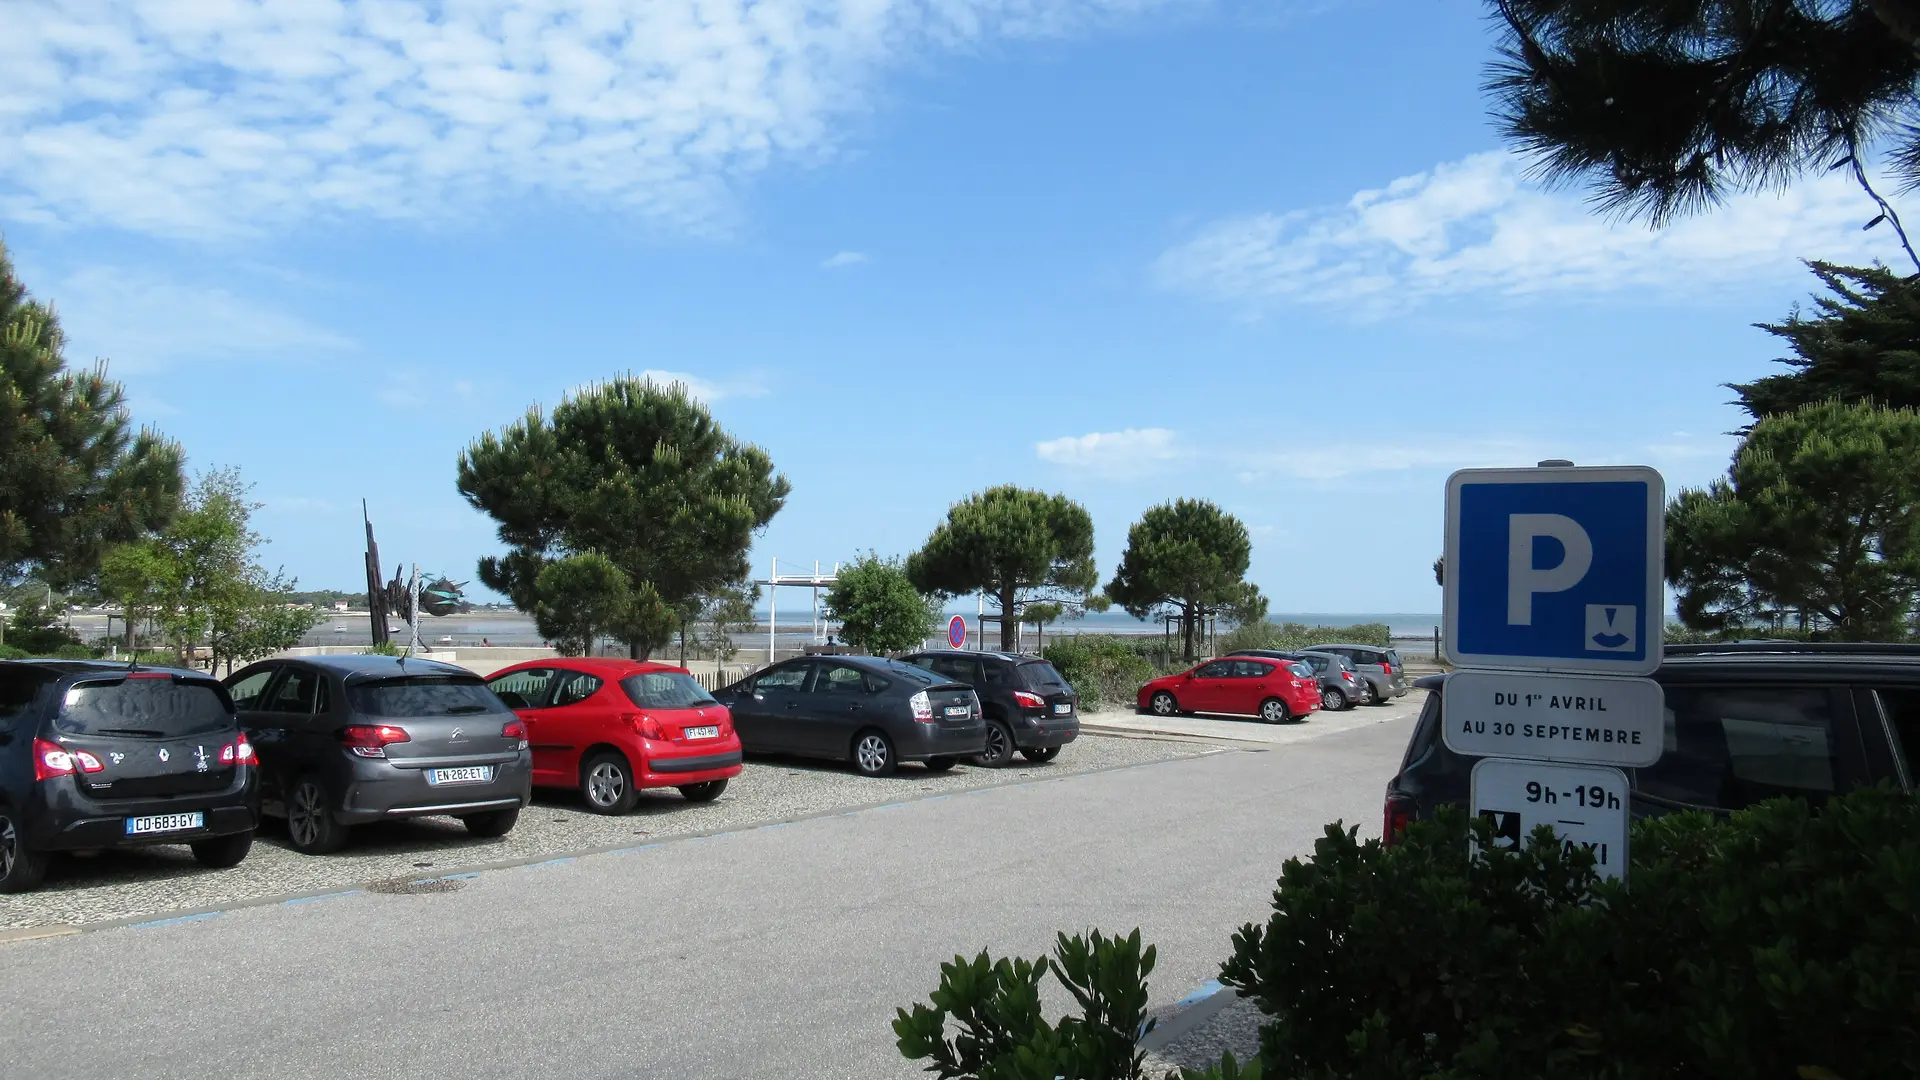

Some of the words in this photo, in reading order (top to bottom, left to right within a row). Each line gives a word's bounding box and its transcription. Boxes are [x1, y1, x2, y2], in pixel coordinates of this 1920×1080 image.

[1507, 513, 1593, 626] P
[1494, 692, 1518, 706] DU
[1549, 695, 1607, 711] AVRIL
[1462, 720, 1485, 734] AU
[1493, 722, 1515, 736] 30
[1523, 724, 1642, 744] SEPTEMBRE
[437, 768, 481, 781] EN-282-ET
[136, 814, 194, 831] CD-683-GY
[1560, 840, 1607, 865] AXI
